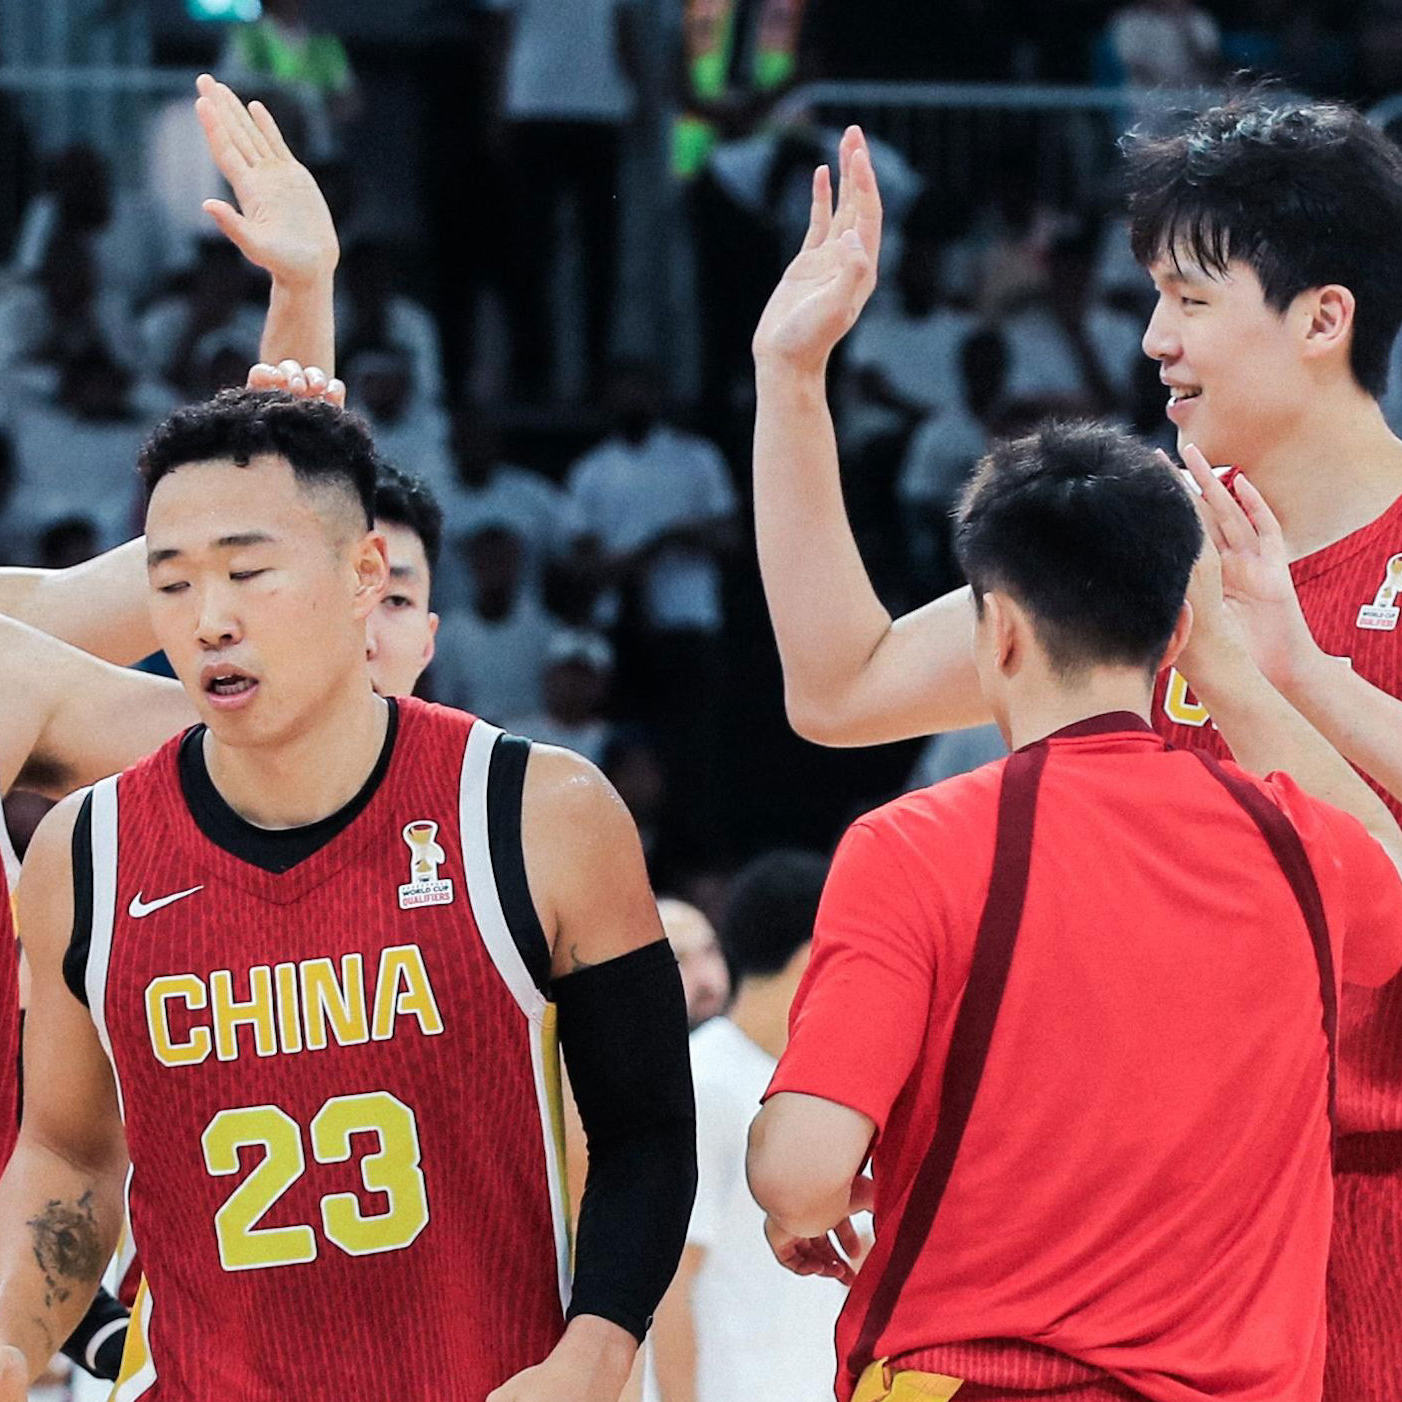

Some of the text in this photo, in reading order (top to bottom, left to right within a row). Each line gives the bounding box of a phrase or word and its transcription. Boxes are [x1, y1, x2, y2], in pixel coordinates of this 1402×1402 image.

[402, 887, 431, 896] WORLD
[144, 944, 445, 1068] CHINA
[201, 1090, 430, 1272] 23
